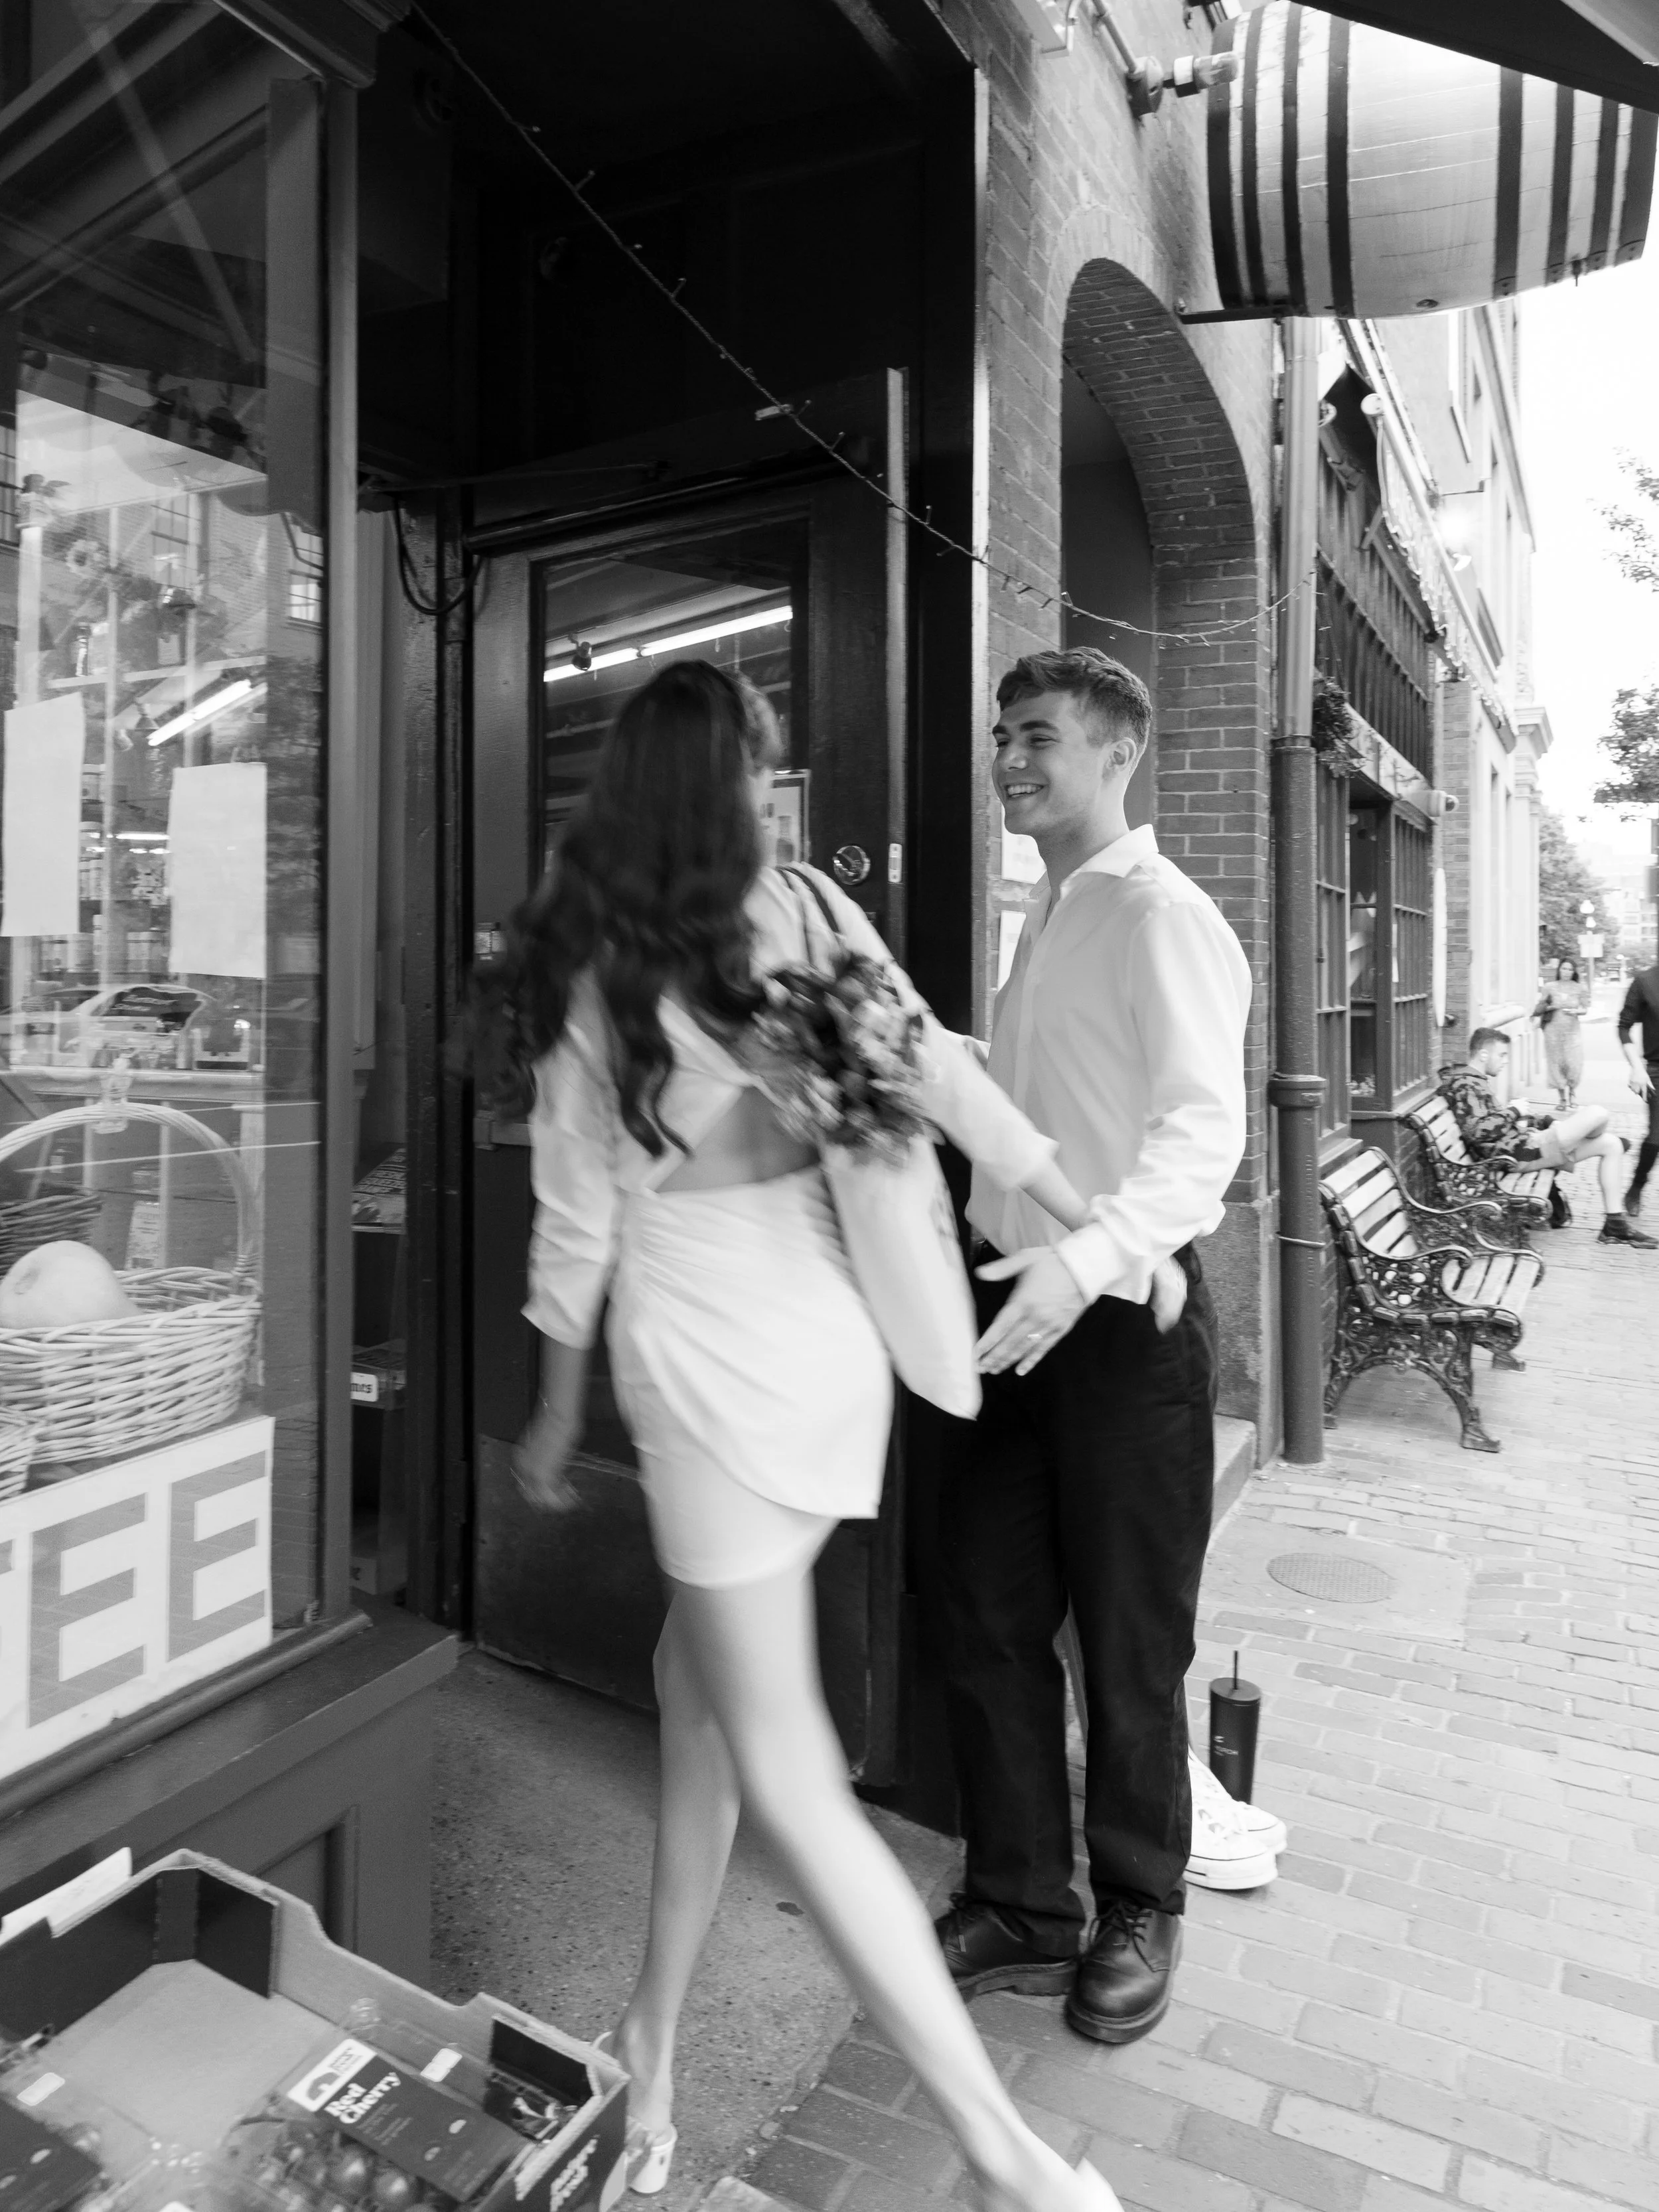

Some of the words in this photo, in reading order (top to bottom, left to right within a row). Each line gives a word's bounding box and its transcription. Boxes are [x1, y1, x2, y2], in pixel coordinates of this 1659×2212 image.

[0, 1449, 268, 1729] EE
[324, 2083, 367, 2116] Red
[339, 2072, 401, 2124] Cherry
